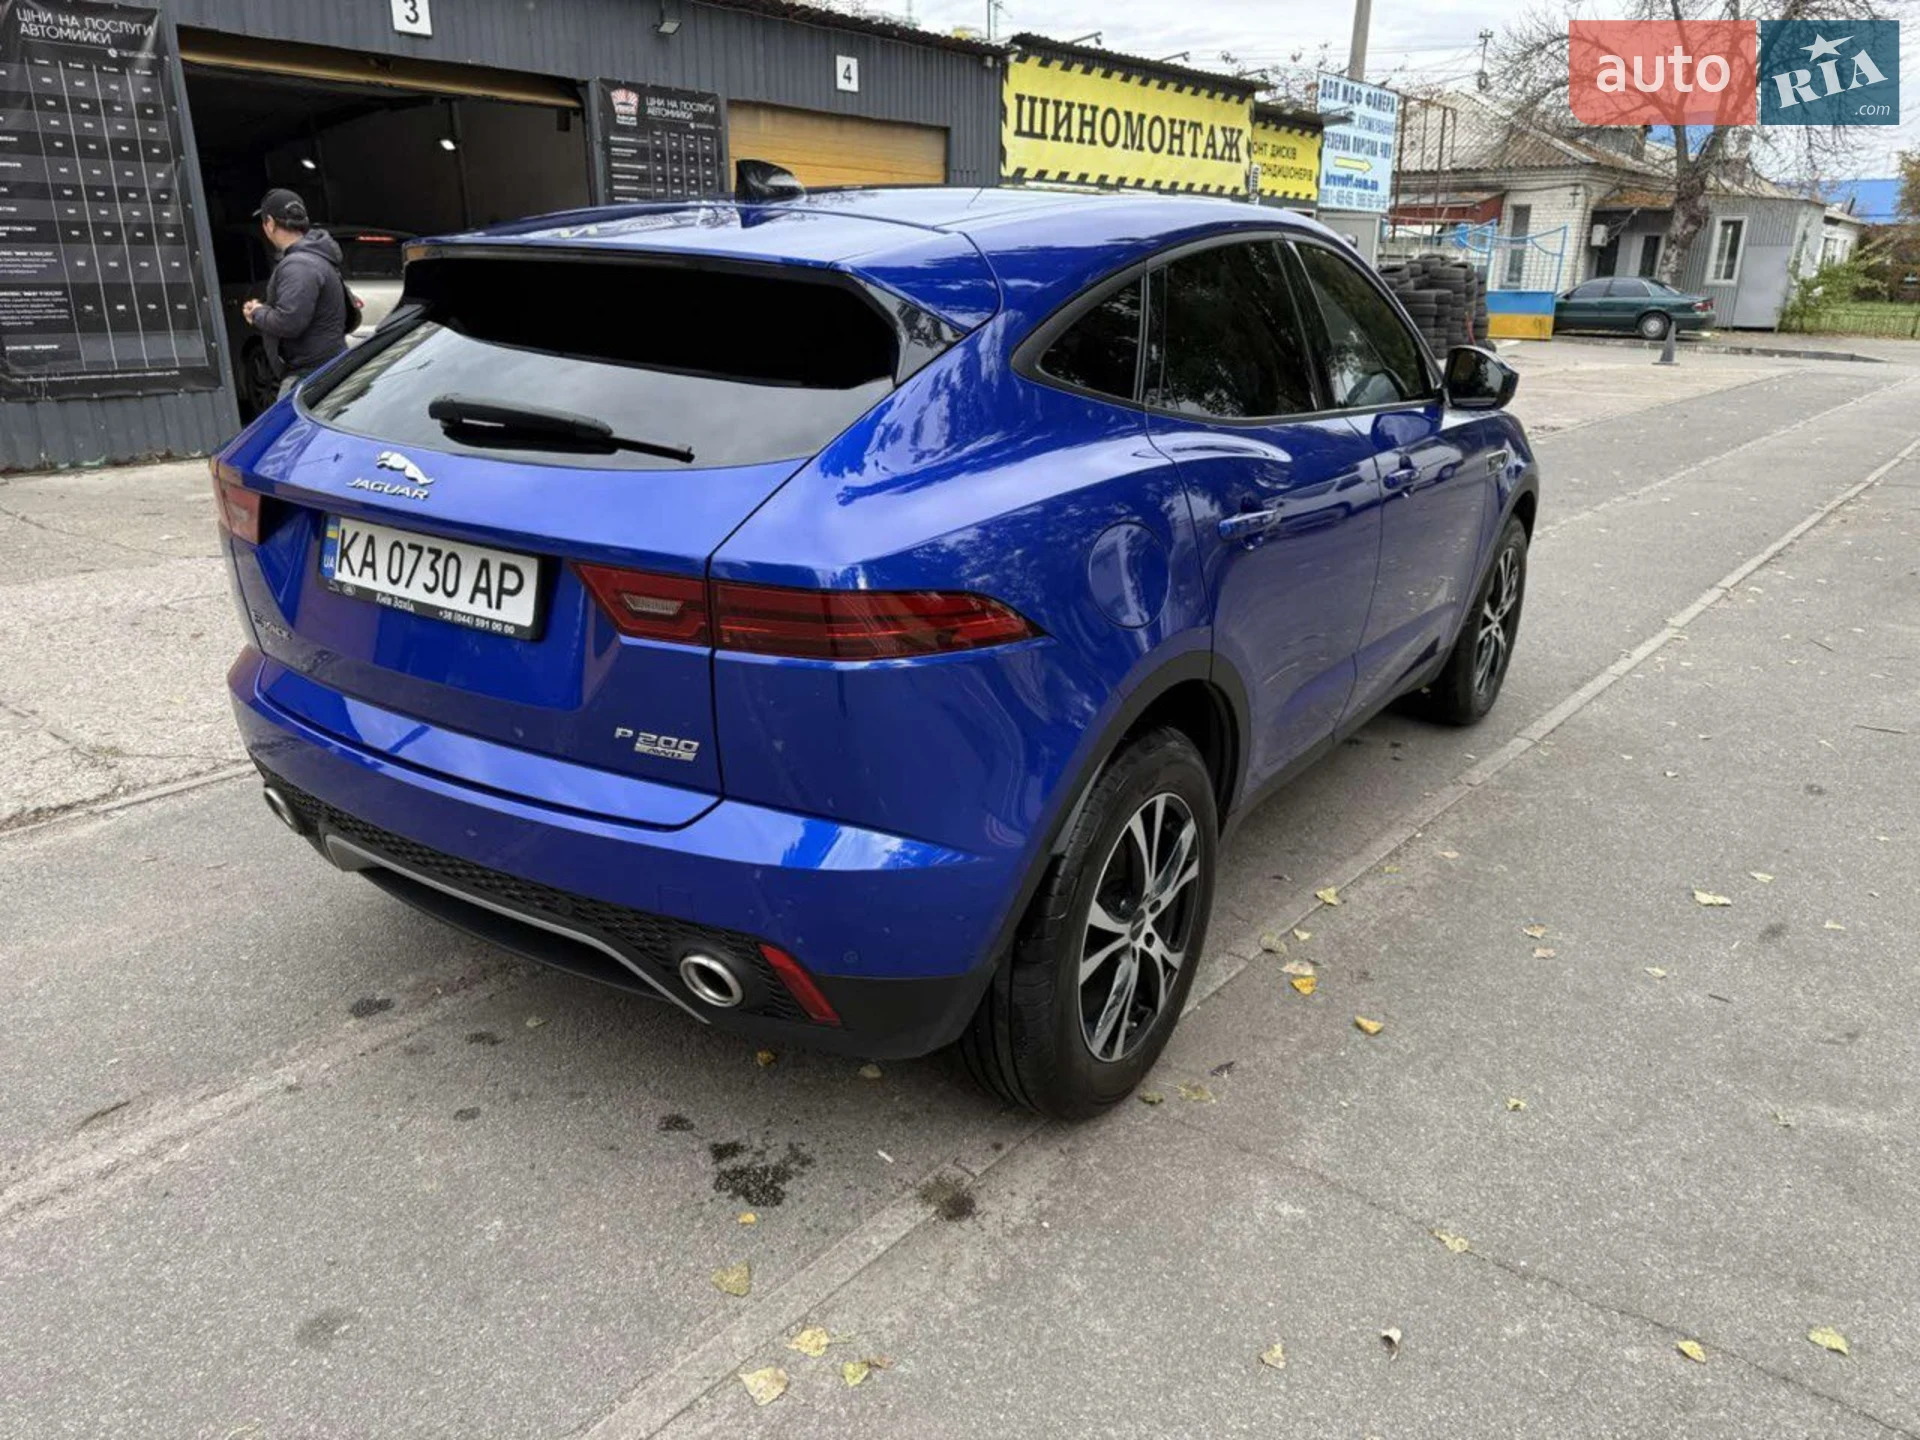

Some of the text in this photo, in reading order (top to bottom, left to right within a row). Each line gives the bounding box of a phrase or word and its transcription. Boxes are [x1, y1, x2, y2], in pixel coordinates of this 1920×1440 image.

[16, 8, 154, 37] ЦІНИ НА ПОСЛУГИ
[404, 0, 419, 24] 3
[20, 23, 112, 45] АВТОМИЙКИ
[843, 63, 852, 85] 4
[1013, 93, 1244, 163] ШИНОМОНТАЖ
[346, 477, 429, 500] JAGUAR
[323, 554, 335, 568] UA
[338, 529, 525, 610] KA 0730 AP
[614, 727, 700, 753] P 200
